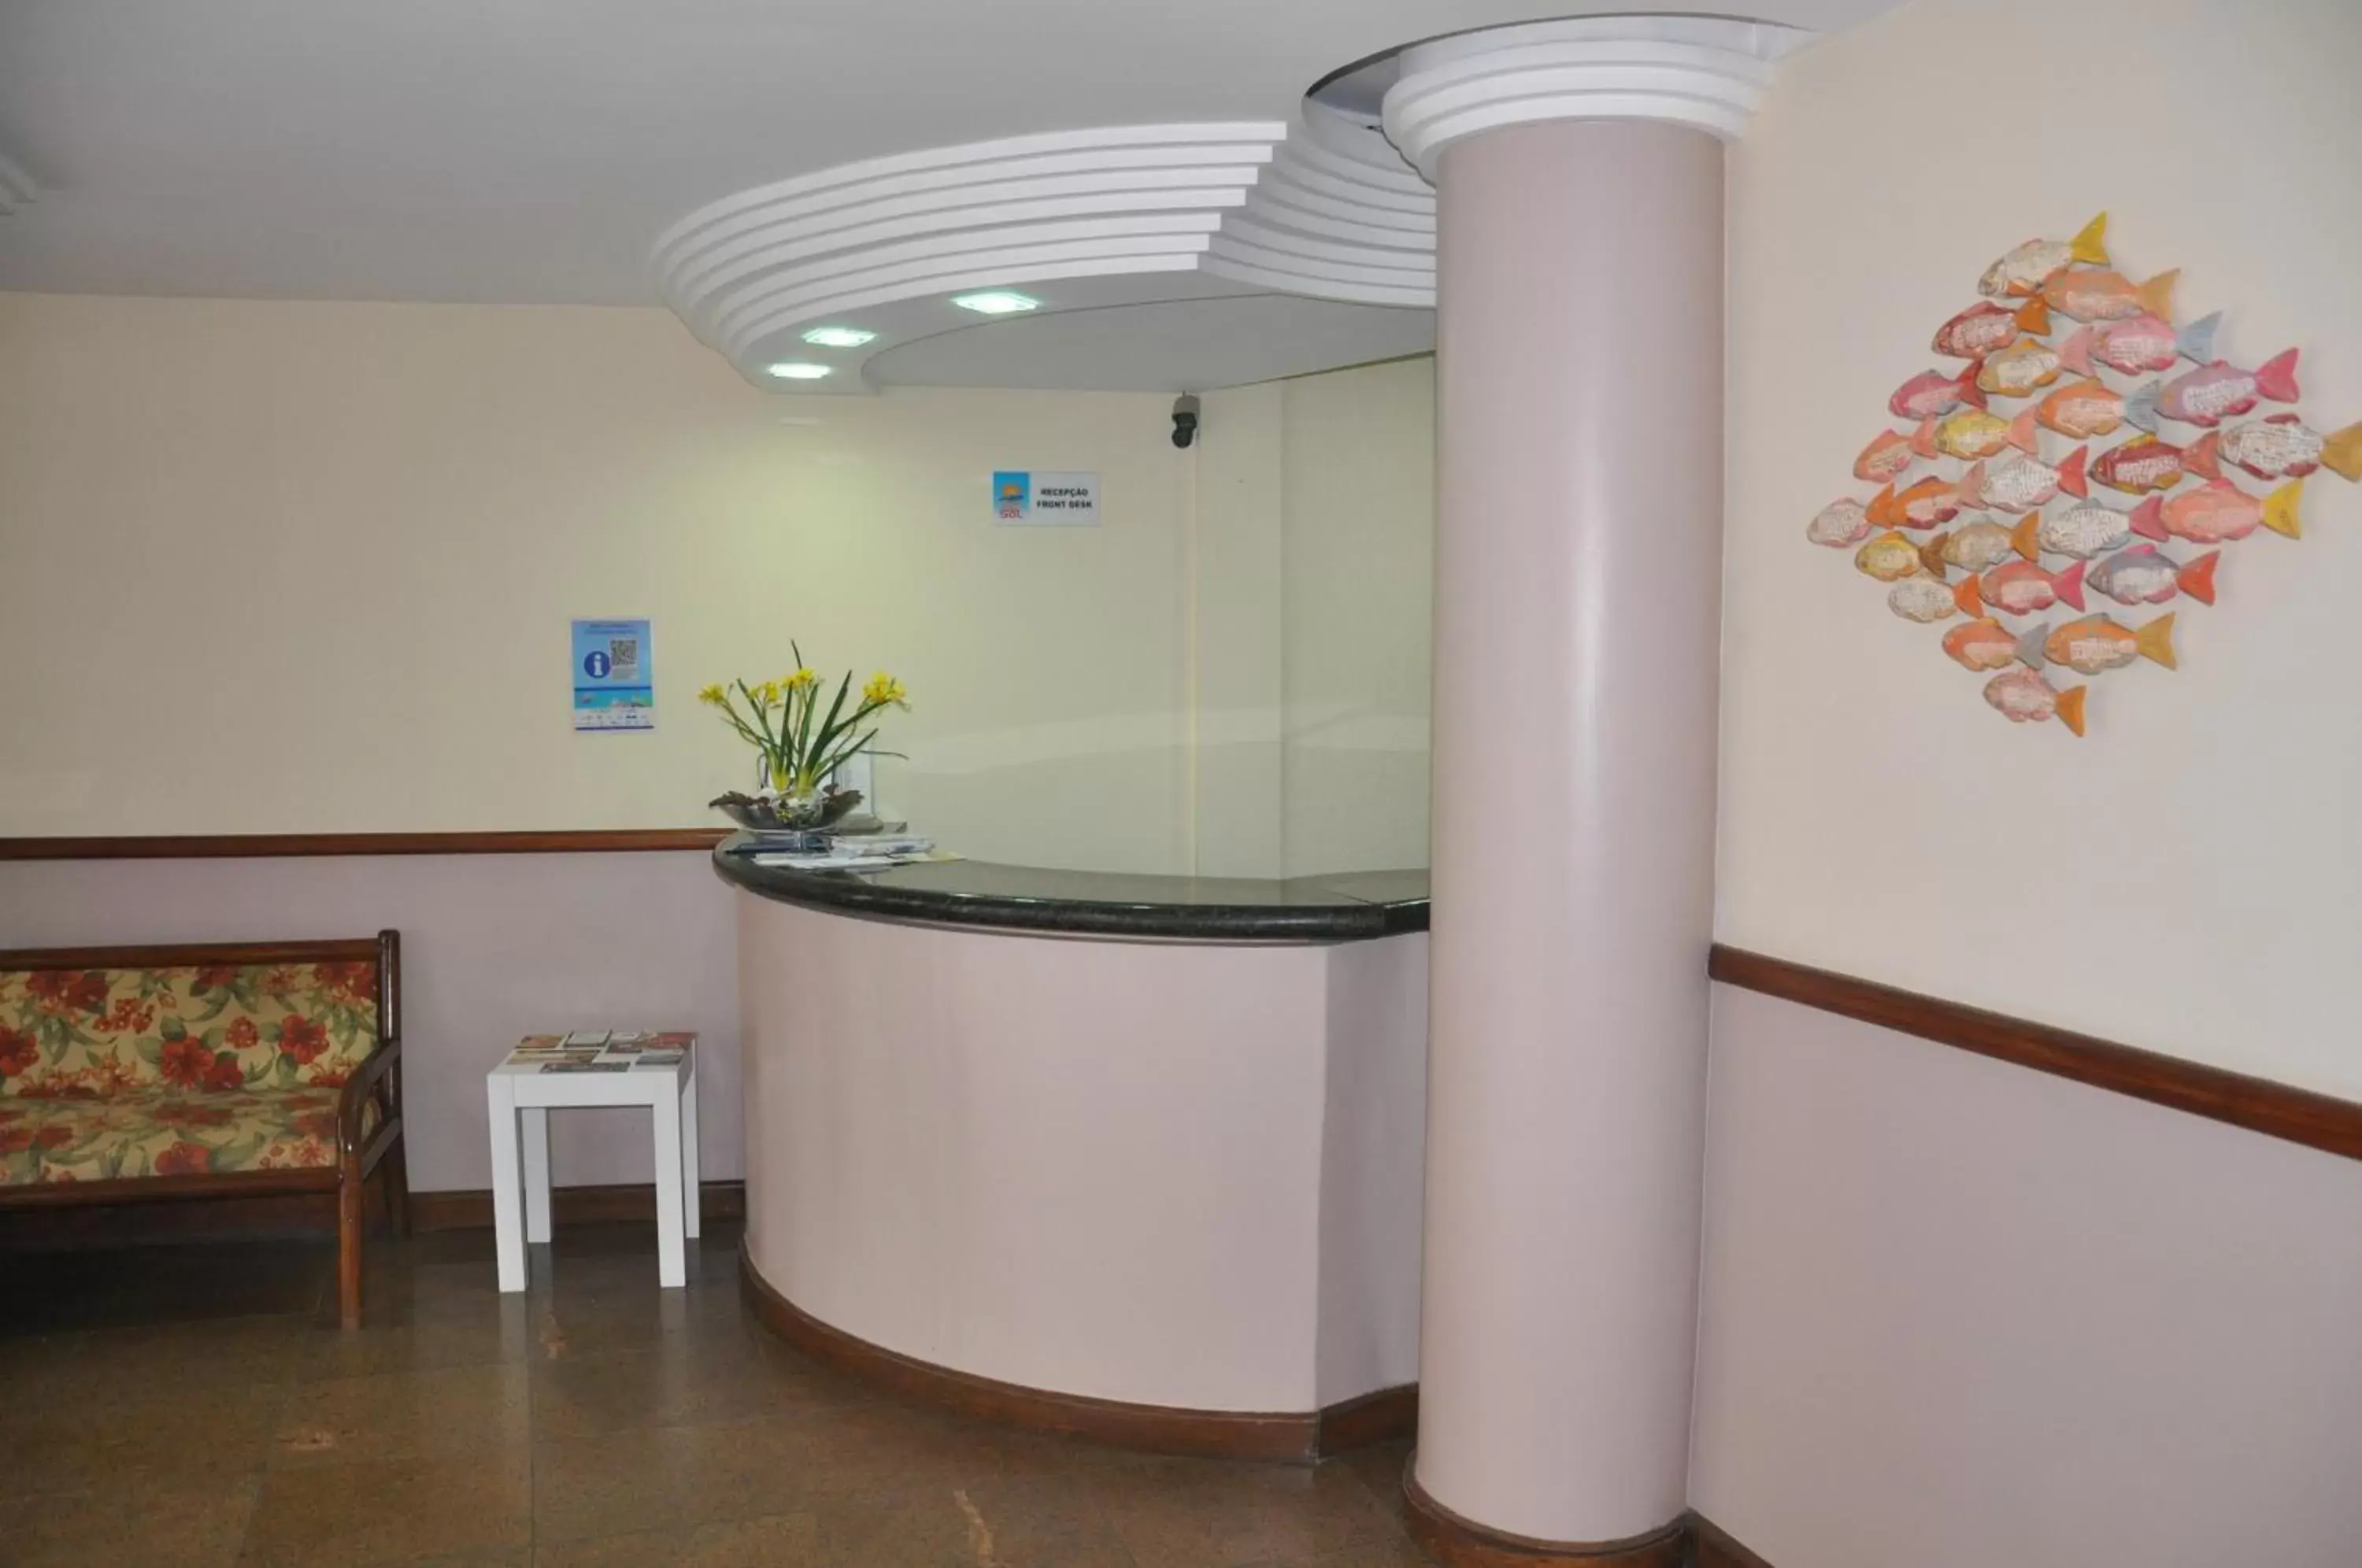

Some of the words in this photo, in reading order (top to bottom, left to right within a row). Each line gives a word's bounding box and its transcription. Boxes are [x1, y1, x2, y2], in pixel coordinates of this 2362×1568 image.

[1041, 487, 1088, 497] RECEPÇÃO
[1036, 500, 1065, 508] FRONT
[1068, 500, 1093, 508] DESK
